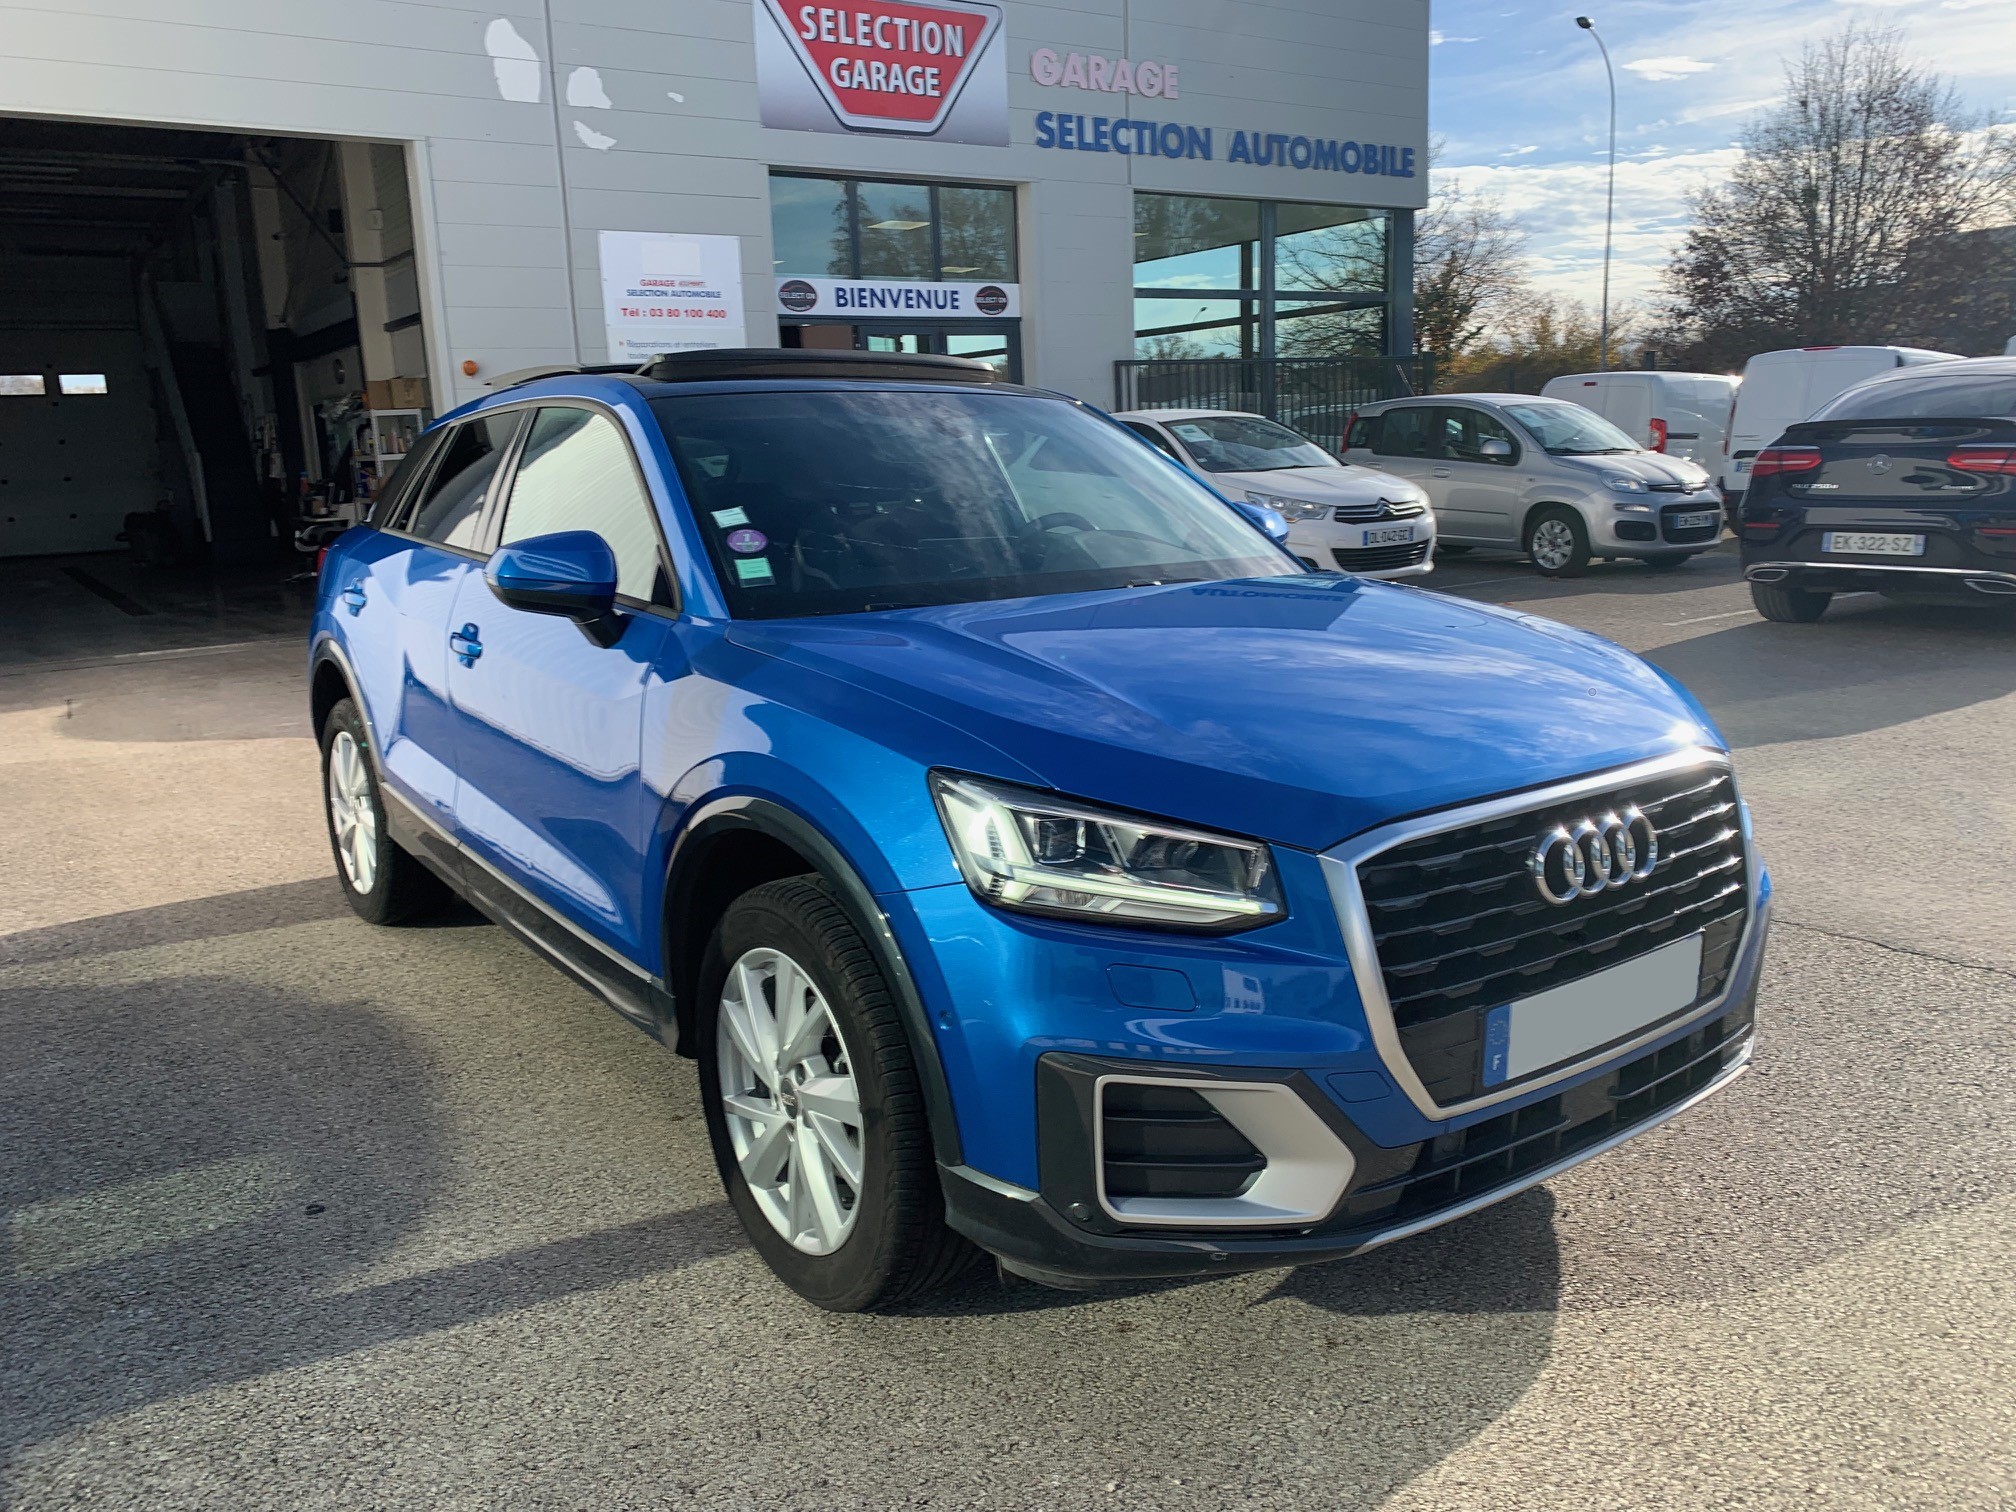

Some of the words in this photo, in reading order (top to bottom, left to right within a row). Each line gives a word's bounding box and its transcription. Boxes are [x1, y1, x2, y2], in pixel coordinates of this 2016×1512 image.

[799, 5, 964, 58] SELECTION
[829, 57, 942, 97] GARAGE
[1030, 47, 1180, 100] GARAGE
[1035, 111, 1212, 161] SELECTION
[1228, 130, 1416, 178] AUTOMOBILE
[639, 279, 675, 287] GARAGE
[626, 289, 668, 297] SELECTION
[671, 290, 722, 298] AUTOMOBILE
[834, 287, 961, 310] BIENVENUE
[649, 308, 663, 317] 03
[667, 308, 680, 317] 80
[684, 309, 704, 318] 100
[706, 309, 727, 319] 400
[743, 533, 751, 542] 1
[1834, 535, 1912, 552] EK-322-SZ
